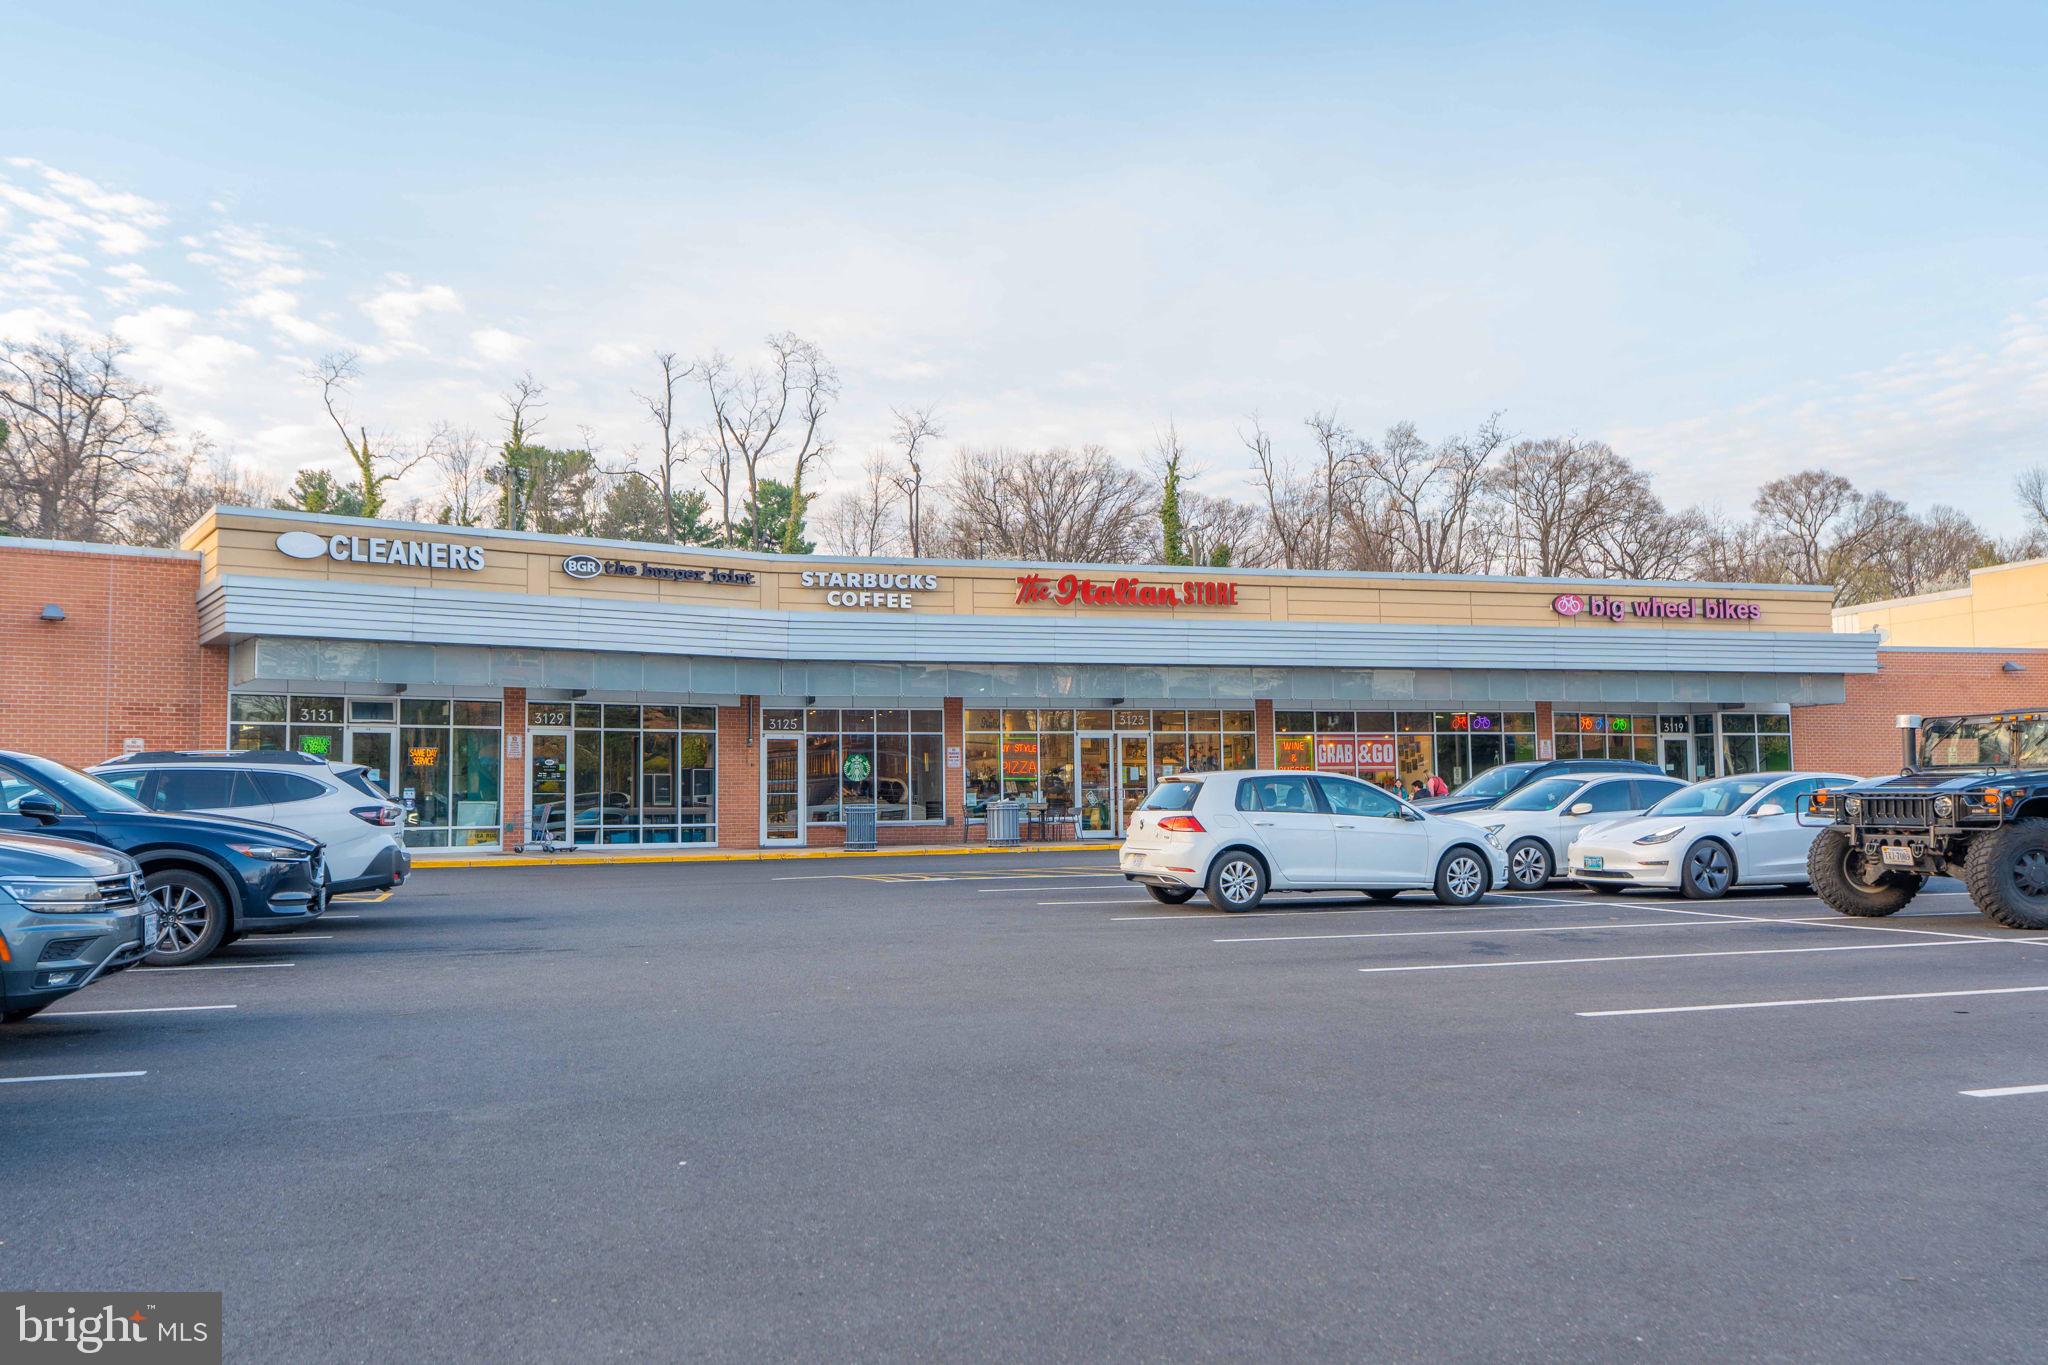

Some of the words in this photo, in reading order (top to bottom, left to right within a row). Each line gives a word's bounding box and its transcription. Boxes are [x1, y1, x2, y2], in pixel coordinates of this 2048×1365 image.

[328, 534, 485, 571] CLEANERS
[567, 560, 597, 573] BGR
[604, 560, 637, 577] the
[641, 562, 706, 582] burger
[709, 566, 756, 585] joint
[801, 571, 937, 590] STARBUCKS
[1015, 573, 1051, 605] The
[1053, 574, 1182, 607] Italian
[1181, 581, 1239, 606] STORE
[827, 590, 912, 609] COFFEE
[1589, 595, 1625, 622] big
[1631, 596, 1697, 618] wheel
[1702, 598, 1761, 620] bikes
[300, 708, 334, 721] 3131
[534, 712, 564, 725] 3129
[1119, 715, 1145, 726] 3123
[768, 718, 798, 730] 3125
[1663, 722, 1684, 732] 3119
[1014, 743, 1037, 753] STYLE
[1283, 741, 1305, 751] WINE
[1290, 753, 1298, 762] &
[1318, 743, 1354, 763] GRAB
